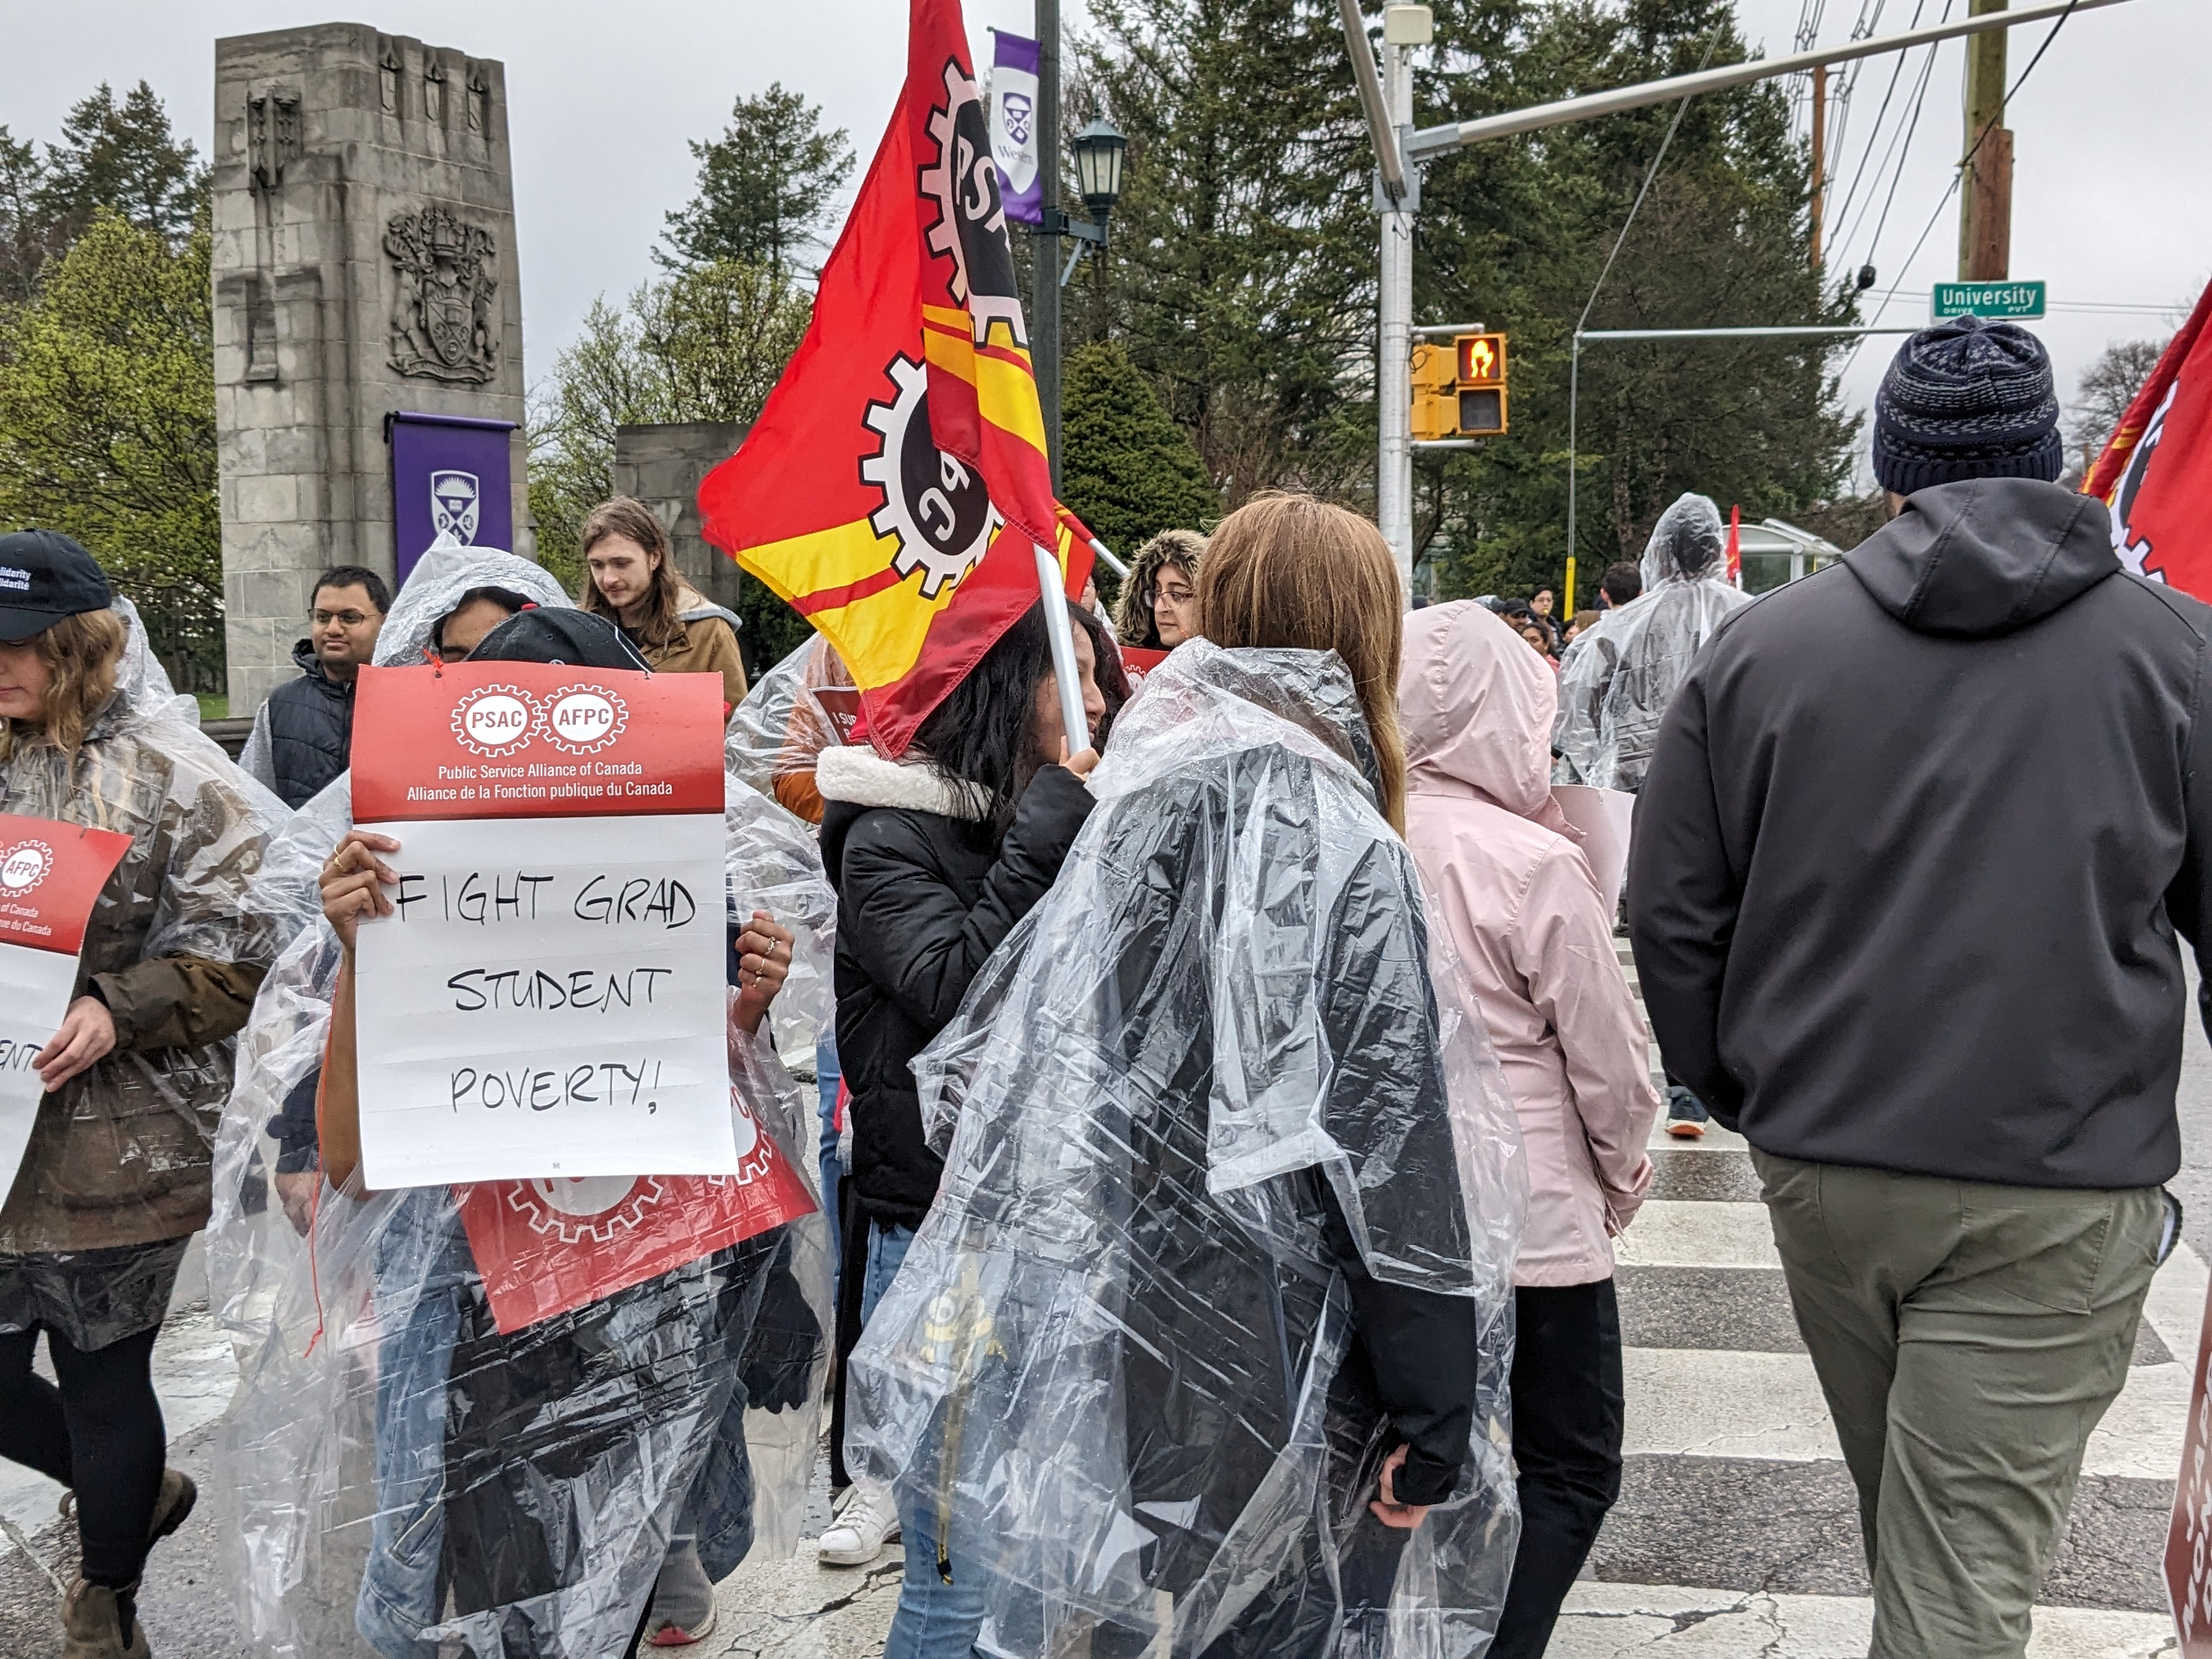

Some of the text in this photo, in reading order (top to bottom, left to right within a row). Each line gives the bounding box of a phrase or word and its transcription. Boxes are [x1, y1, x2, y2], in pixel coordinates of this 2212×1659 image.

[1943, 286, 2036, 307] University
[0, 567, 31, 581] lidarity
[471, 707, 610, 729] PSAC AFPC
[438, 761, 642, 780] Public Service Alliance of Canada
[407, 781, 673, 801] Alliance de la Fonction publique du Canada
[5, 860, 40, 877] AFPC
[1, 903, 38, 917] of Canada
[396, 871, 696, 929] FIGHT GRAD
[11, 919, 22, 930] du
[22, 921, 52, 935] Canada
[447, 968, 672, 1013] STUDENT
[452, 1058, 662, 1114] POVERTY!
